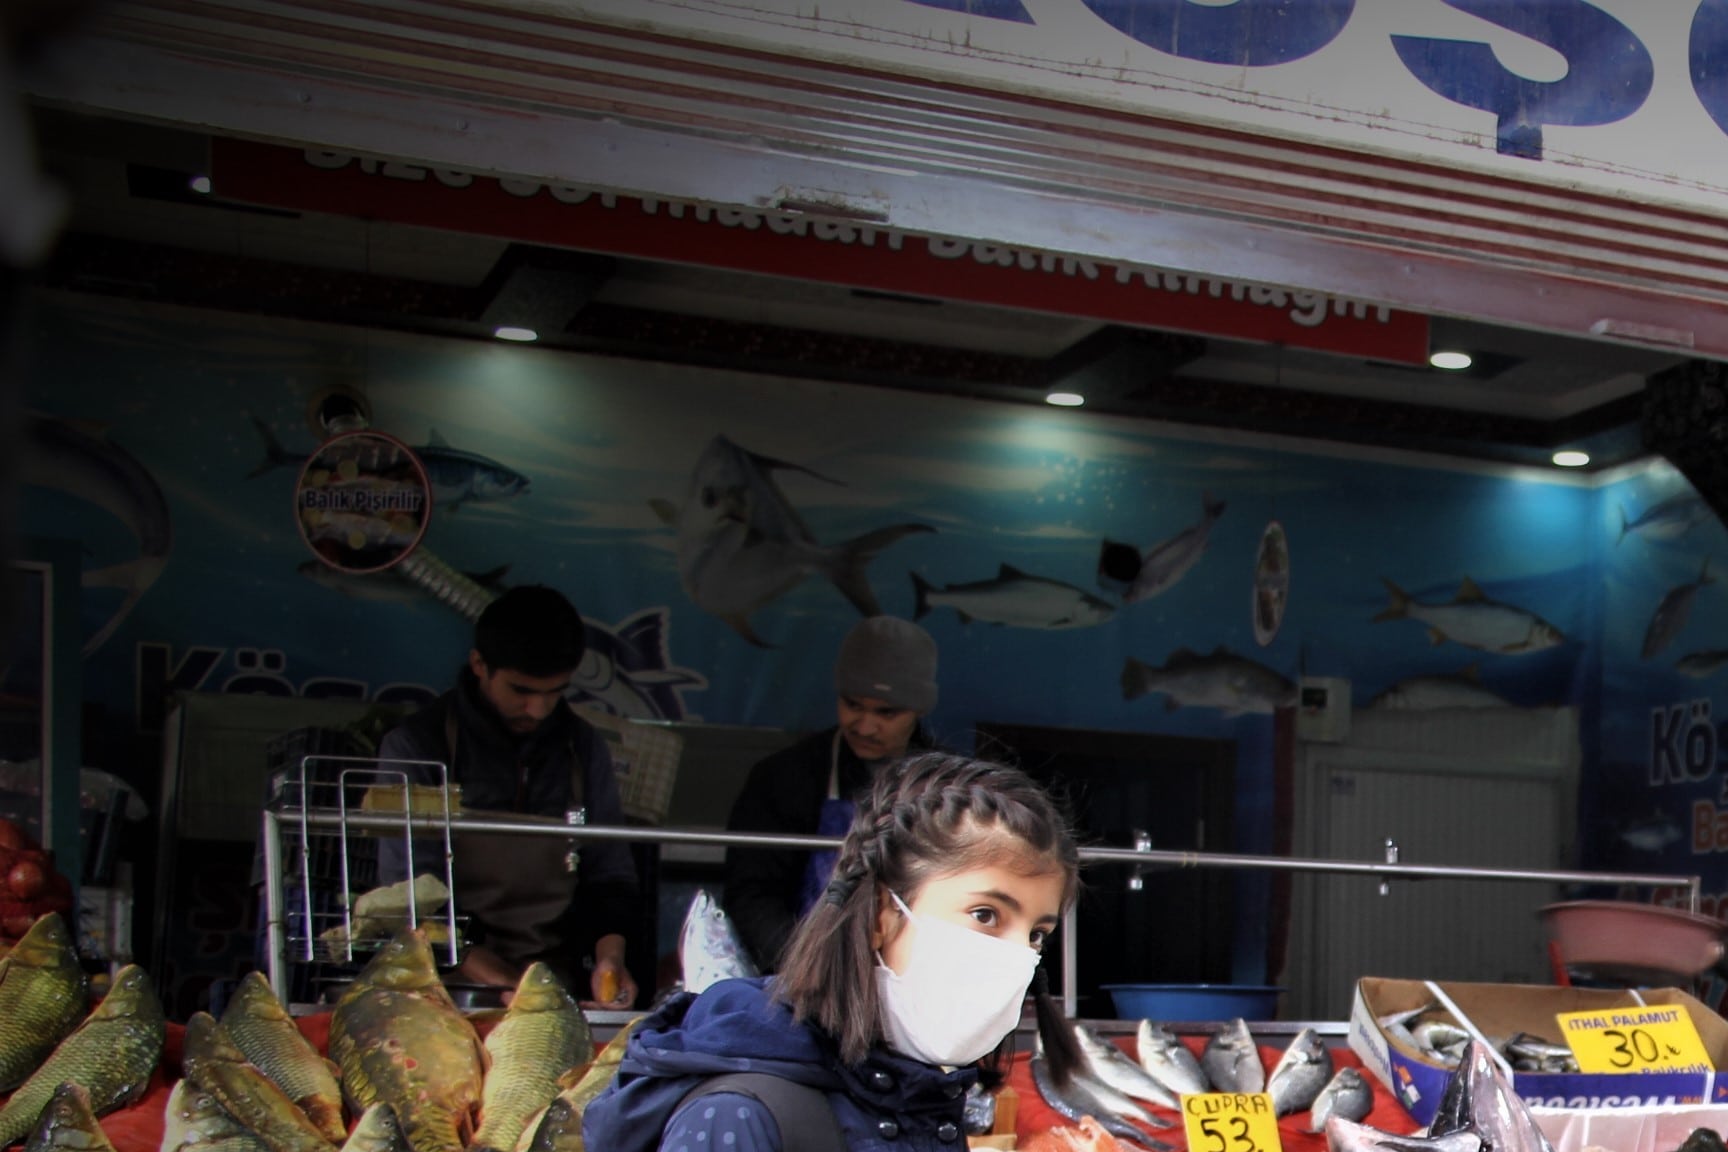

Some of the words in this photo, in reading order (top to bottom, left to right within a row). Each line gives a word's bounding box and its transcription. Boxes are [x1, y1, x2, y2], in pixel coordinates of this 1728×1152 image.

[306, 490, 349, 508] Balık
[355, 490, 423, 511] Pişirilir
[1612, 1009, 1680, 1027] PALAMUT
